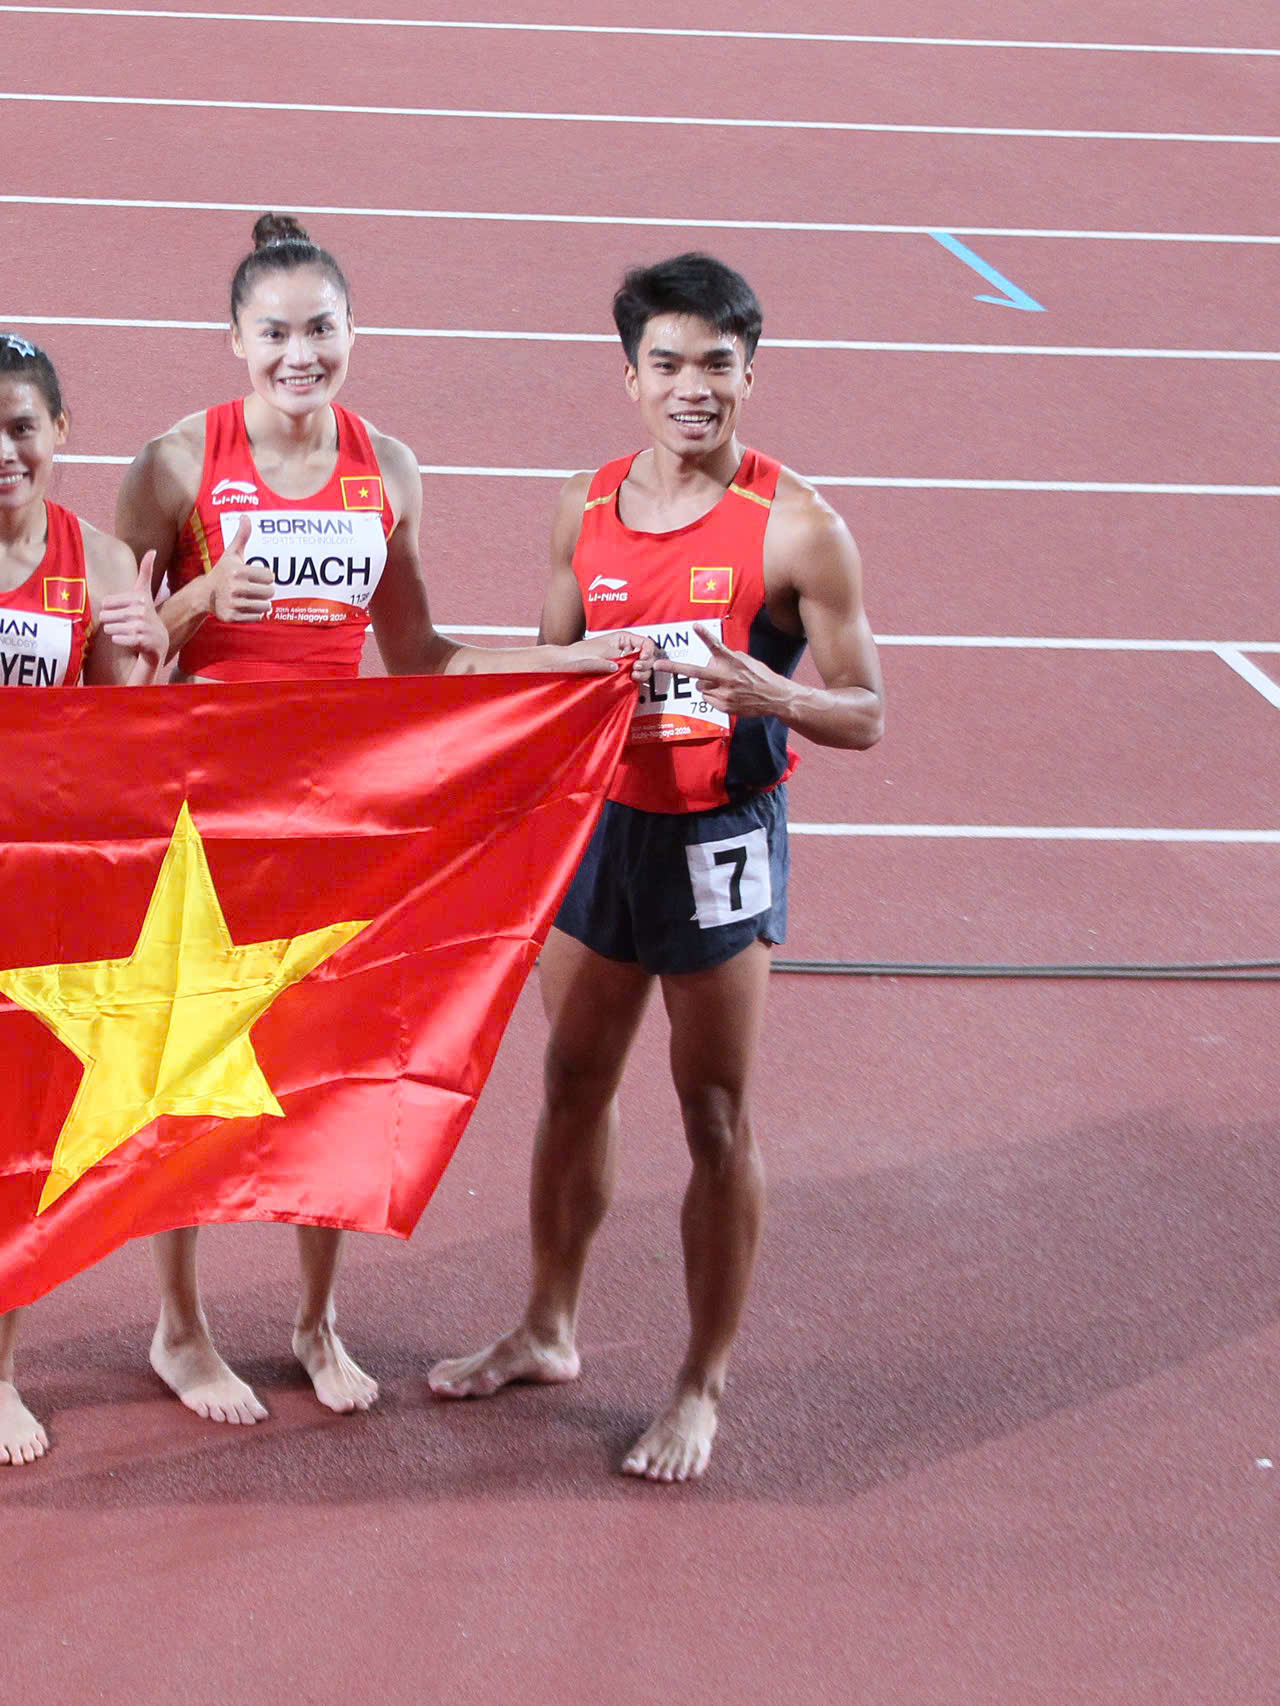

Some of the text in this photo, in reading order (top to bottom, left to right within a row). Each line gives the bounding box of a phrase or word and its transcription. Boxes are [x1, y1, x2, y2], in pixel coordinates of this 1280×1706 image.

[258, 518, 353, 534] BORNAN
[588, 591, 629, 602] LI-NING
[274, 613, 328, 623] Aichi-Nagoya
[648, 631, 689, 649] NAN
[713, 845, 747, 911] 7
